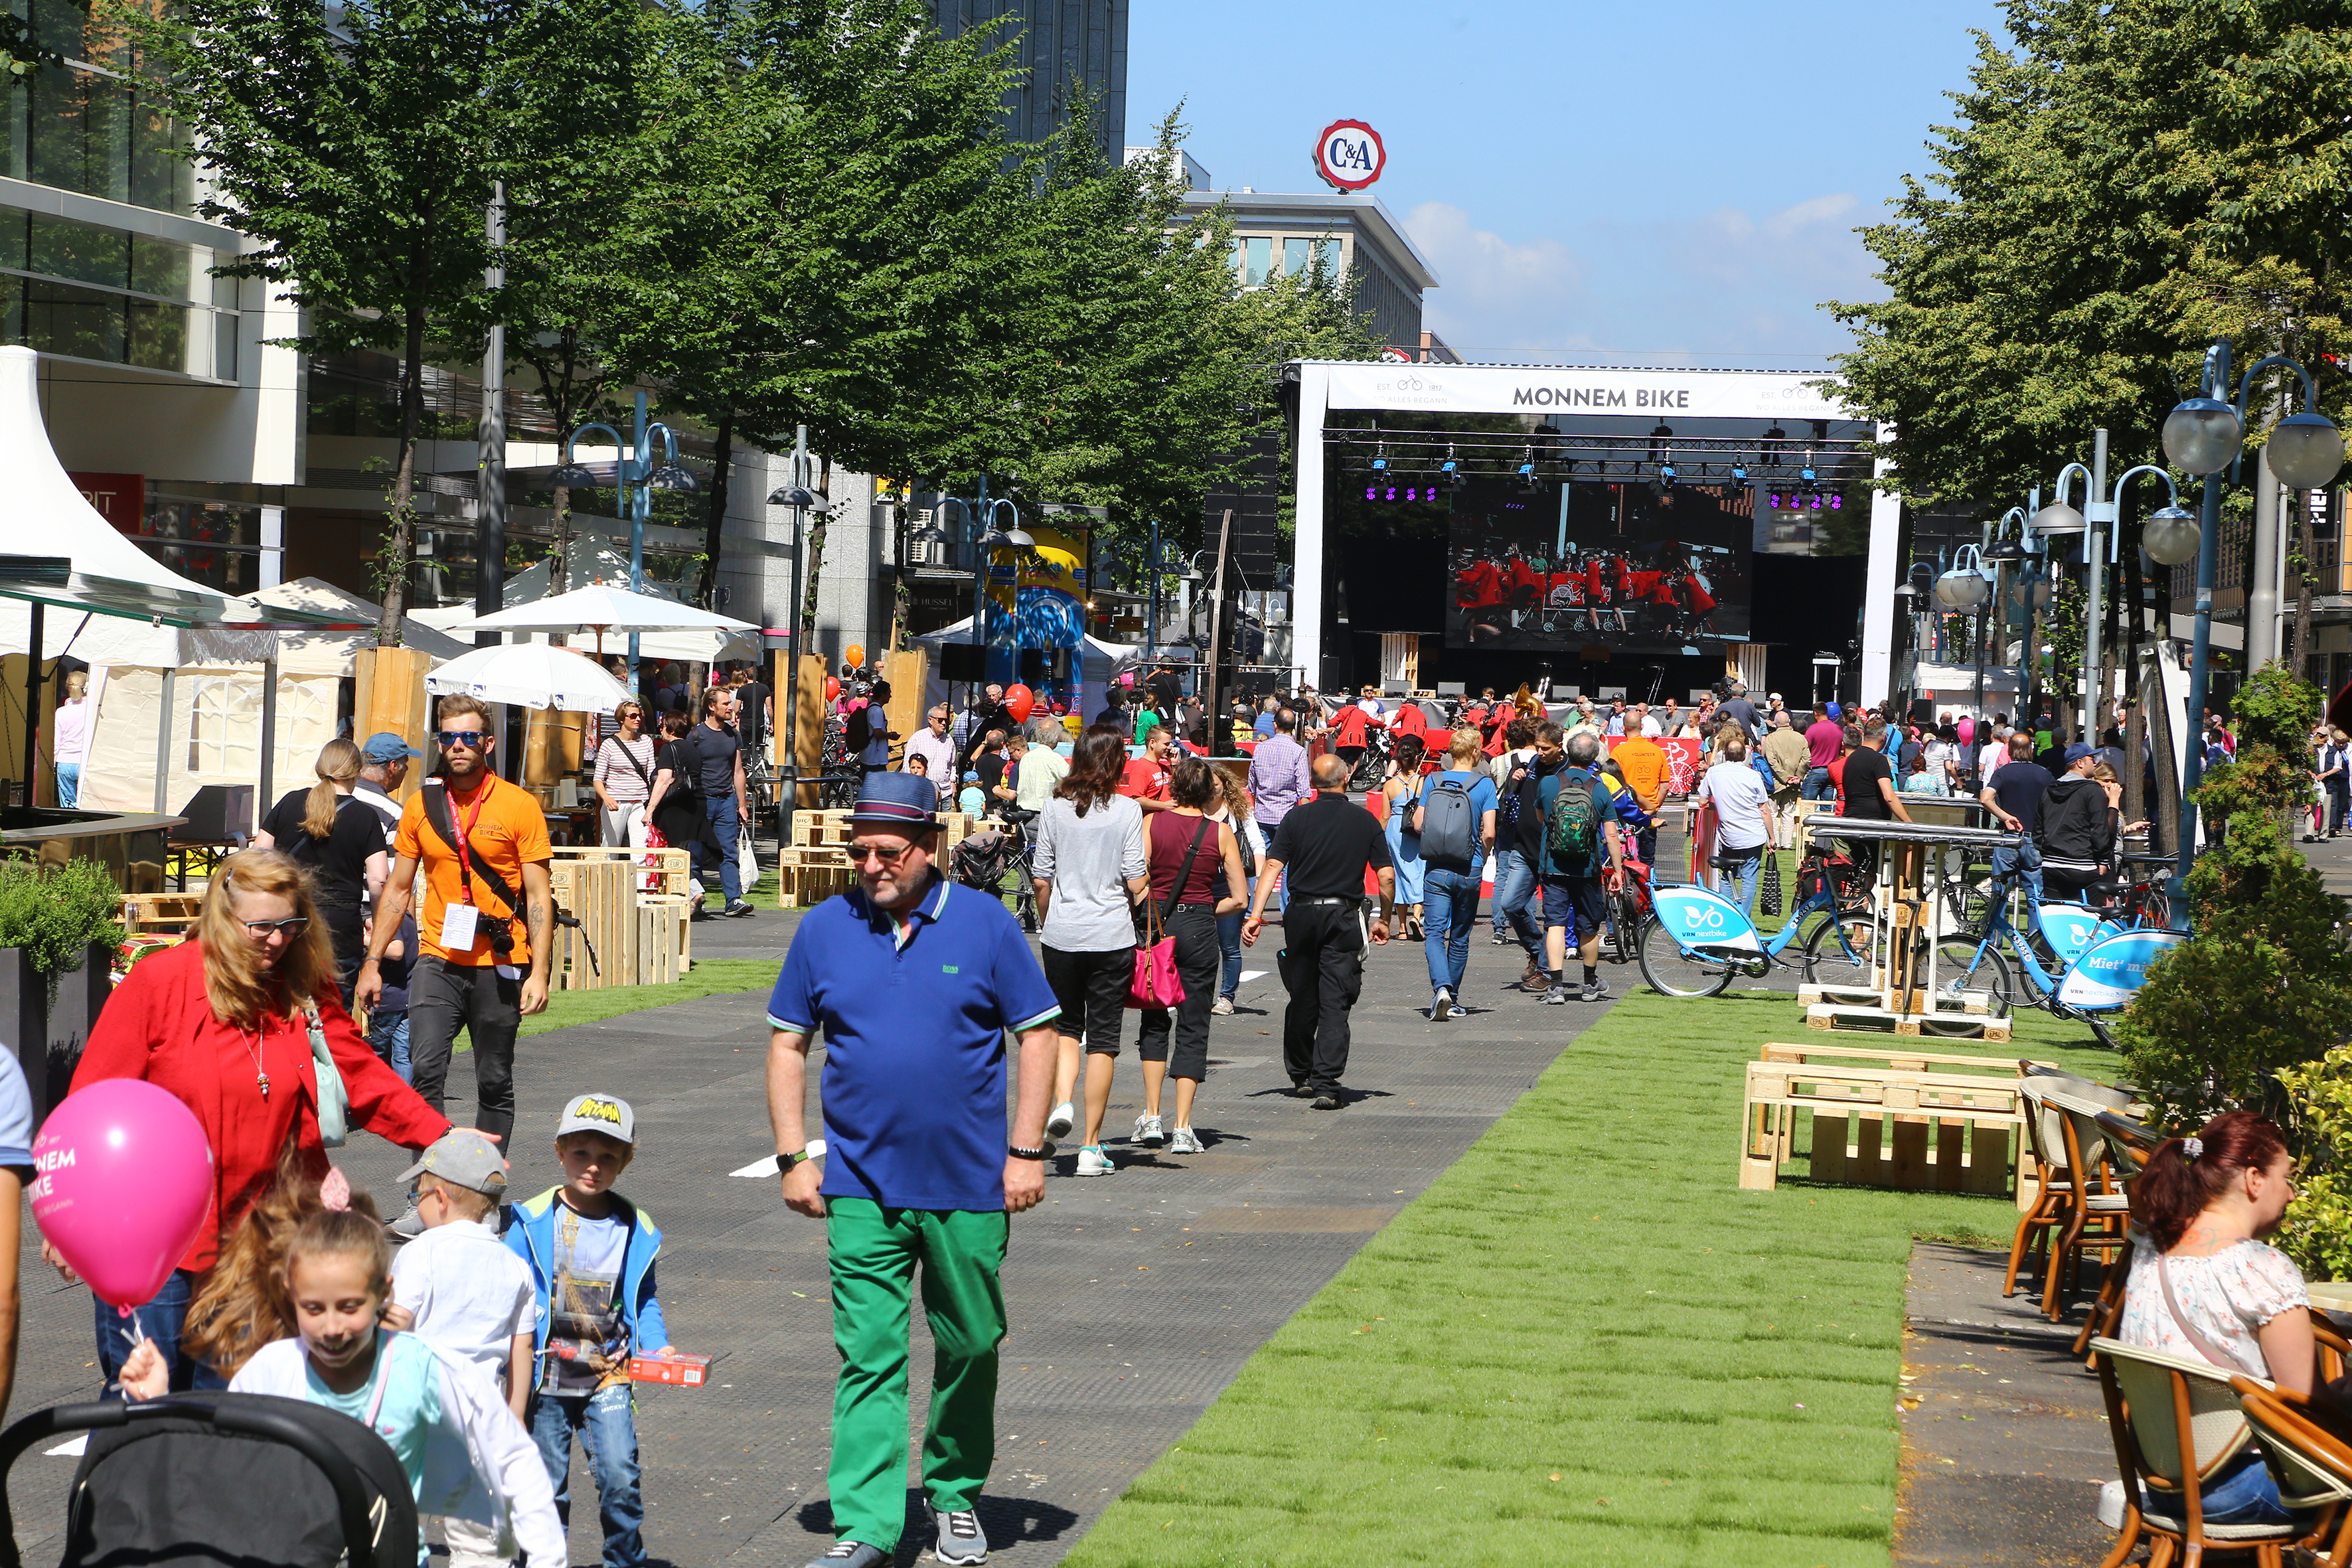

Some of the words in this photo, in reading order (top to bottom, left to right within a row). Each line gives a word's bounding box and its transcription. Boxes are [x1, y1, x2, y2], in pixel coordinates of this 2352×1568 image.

[1330, 137, 1373, 171] C&A
[1513, 387, 1626, 407] MONNEM
[1636, 389, 1689, 408] BIKE
[1794, 905, 1809, 923] 43949
[2012, 935, 2029, 955] 43965
[575, 1098, 621, 1123] BATMAN
[601, 1403, 626, 1414] MICKEY
